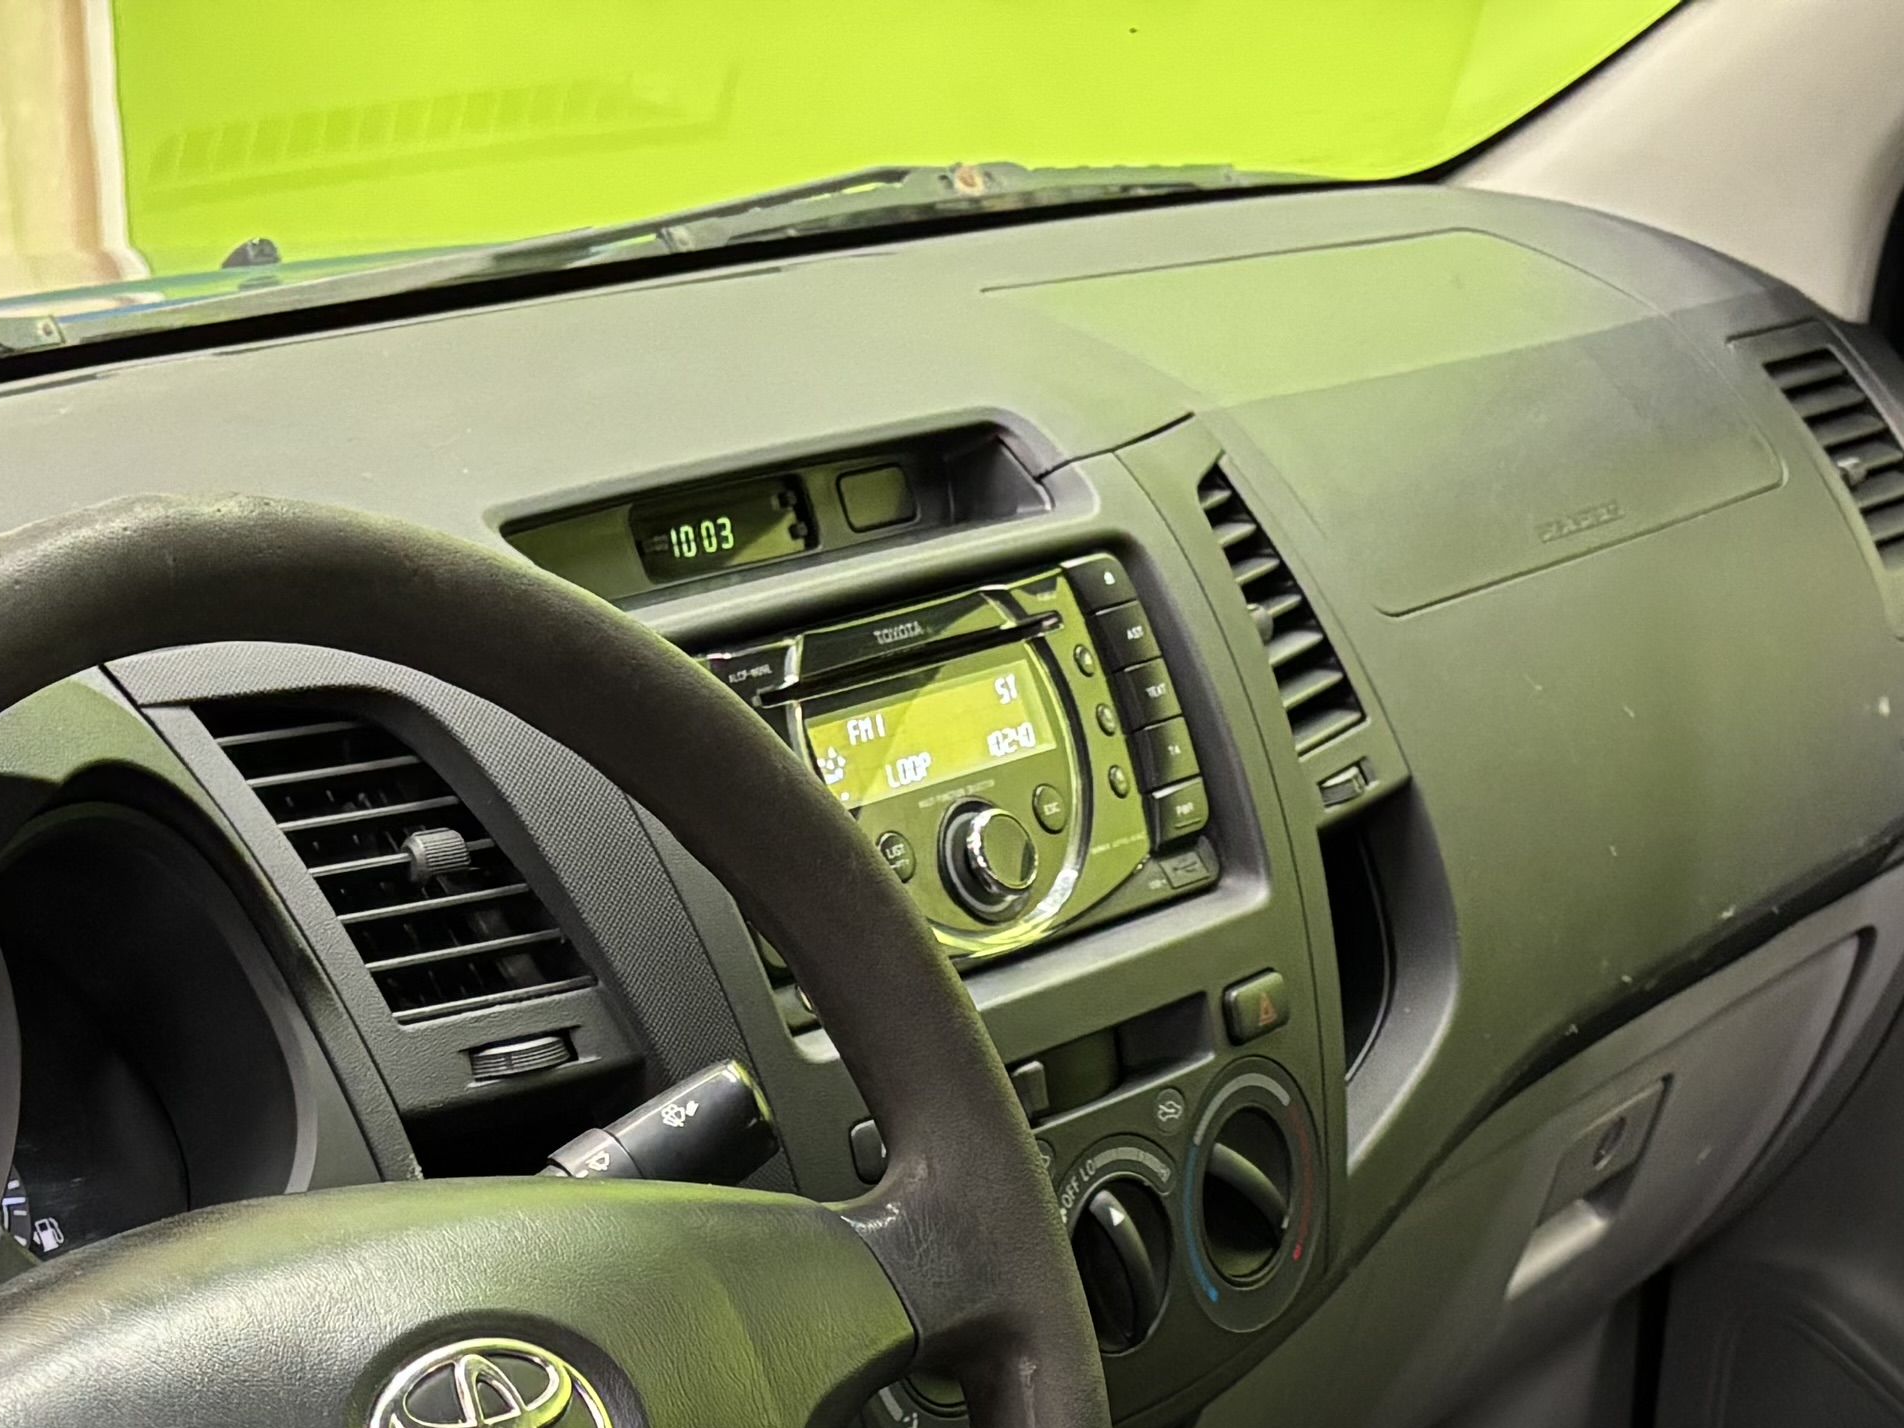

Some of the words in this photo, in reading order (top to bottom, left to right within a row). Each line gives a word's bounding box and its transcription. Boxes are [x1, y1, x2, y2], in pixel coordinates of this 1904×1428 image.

[873, 621, 925, 645] TOYOTA
[885, 751, 932, 788] LOOP
[1061, 1176, 1080, 1208] OFF
